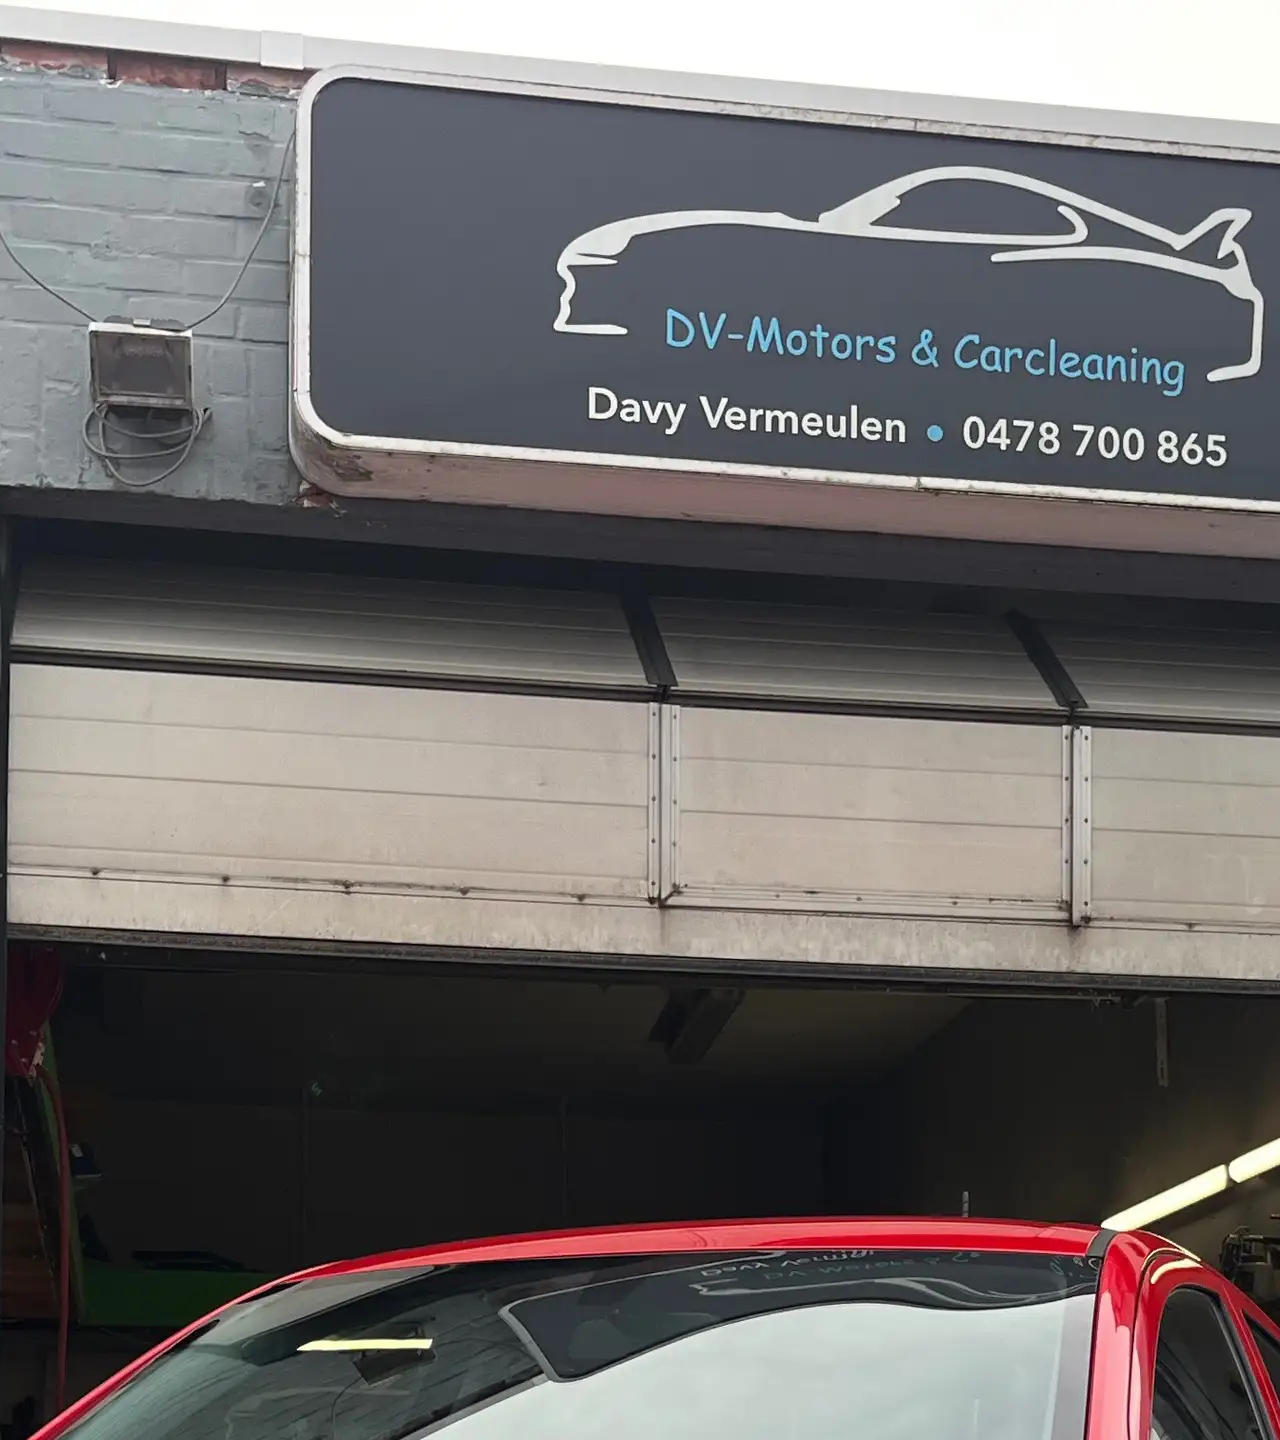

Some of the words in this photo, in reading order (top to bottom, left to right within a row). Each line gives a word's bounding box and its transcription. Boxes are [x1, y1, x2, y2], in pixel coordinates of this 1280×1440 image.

[666, 308, 896, 363] DV-Motors
[911, 329, 939, 368] &
[954, 333, 1185, 397] Carcleaning
[588, 386, 687, 435] Davy
[699, 396, 906, 443] Vermeulen
[962, 416, 1061, 455] 0478
[1072, 424, 1145, 461] 700
[1156, 430, 1228, 467] 865
